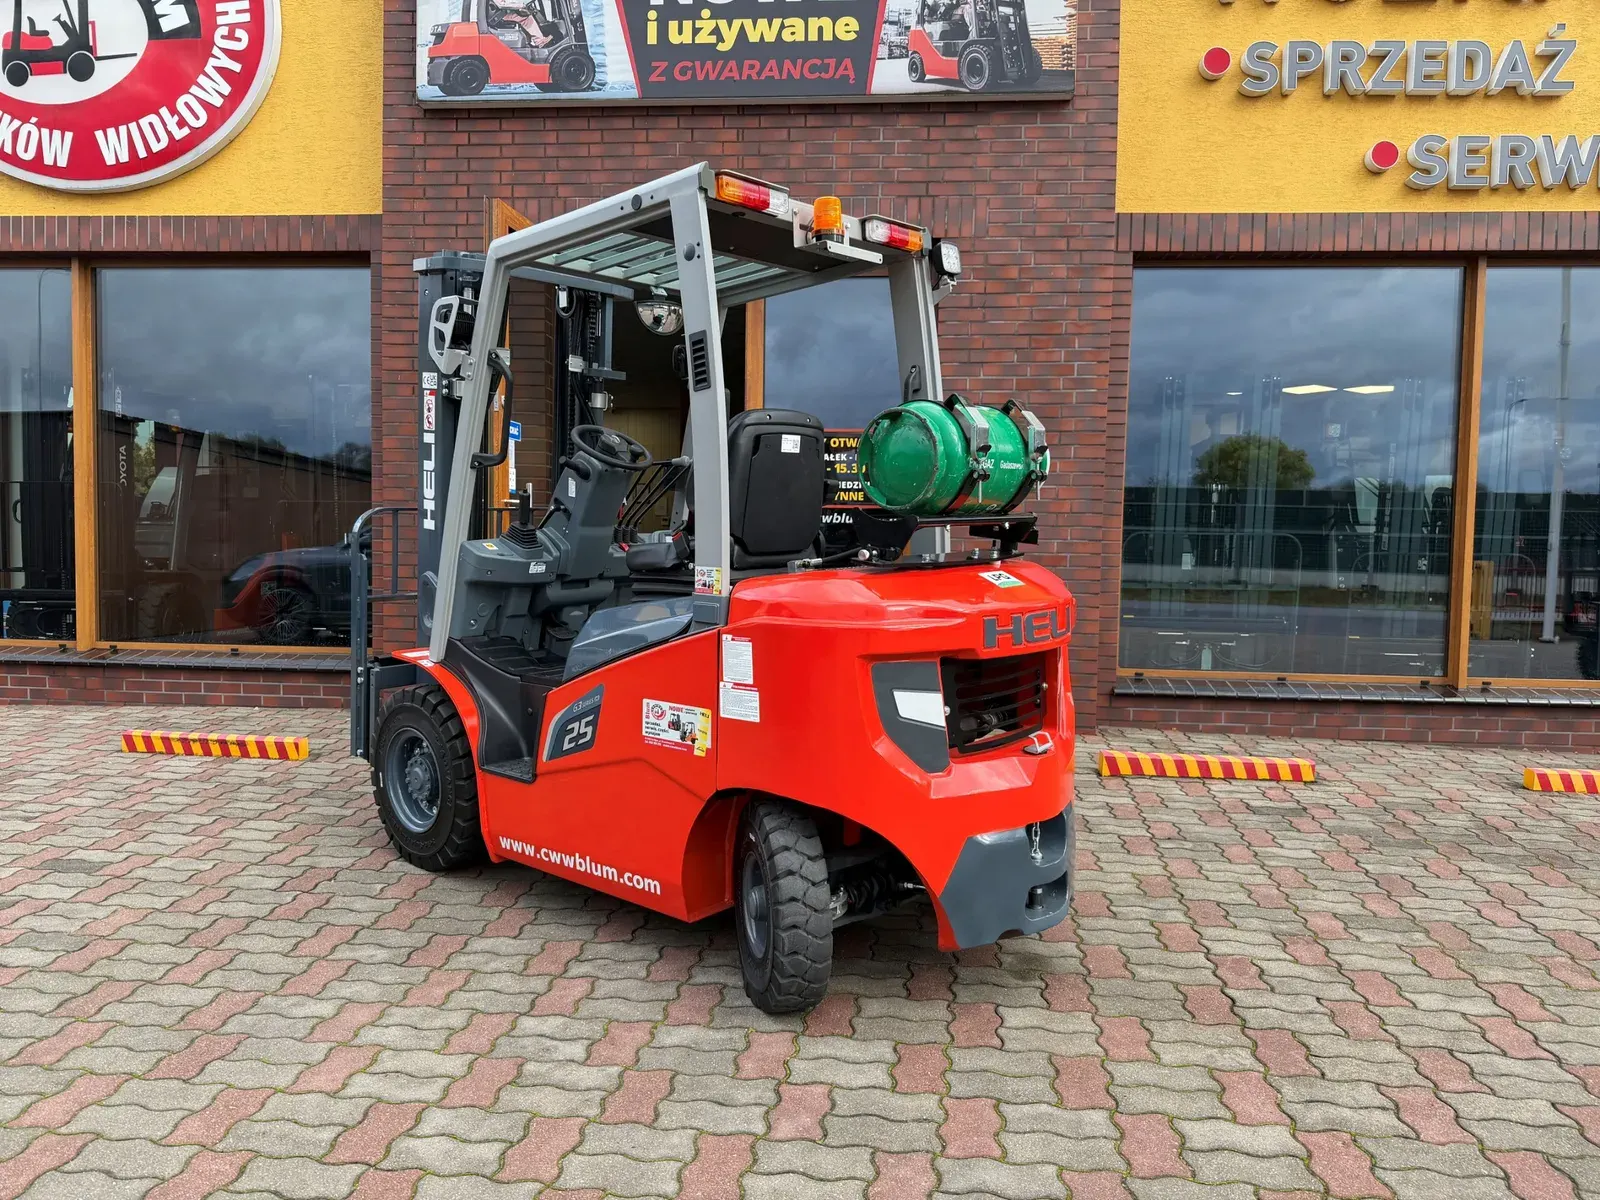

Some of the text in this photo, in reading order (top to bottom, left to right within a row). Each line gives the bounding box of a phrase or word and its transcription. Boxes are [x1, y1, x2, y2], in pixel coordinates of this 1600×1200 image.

[647, 8, 860, 52] i używane
[0, 0, 251, 168] KÓW WIDŁOWYCH
[648, 58, 856, 84] Z GWARANCJĄ
[1239, 23, 1578, 96] SPRZEDAŻ
[1406, 134, 1600, 190] SERW
[830, 438, 860, 448] OTW
[423, 432, 436, 531] HELI
[563, 714, 595, 751] 25
[499, 836, 661, 895] www.cwwblum.com
